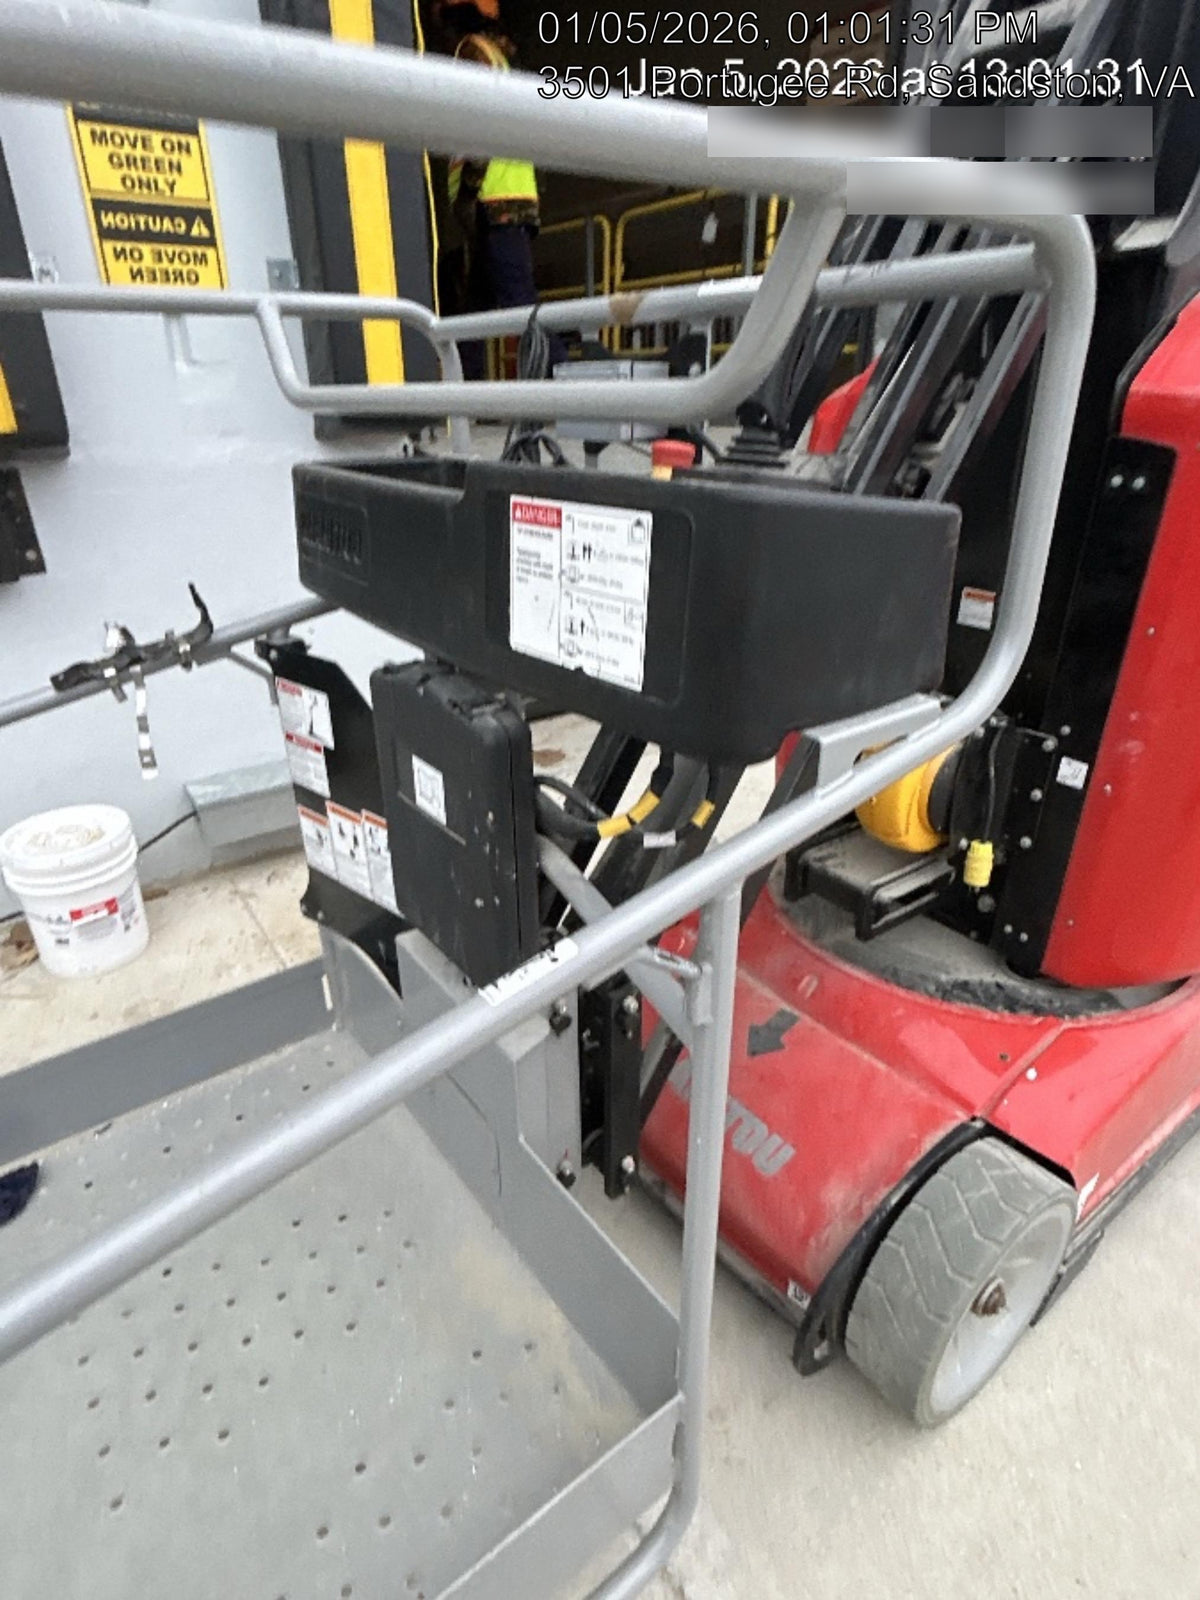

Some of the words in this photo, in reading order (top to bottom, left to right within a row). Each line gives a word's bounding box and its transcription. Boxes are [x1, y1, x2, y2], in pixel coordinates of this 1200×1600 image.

[90, 129, 154, 150] MOVE
[161, 138, 193, 157] ON
[108, 152, 183, 176] GREEN
[120, 174, 177, 196] ONLY
